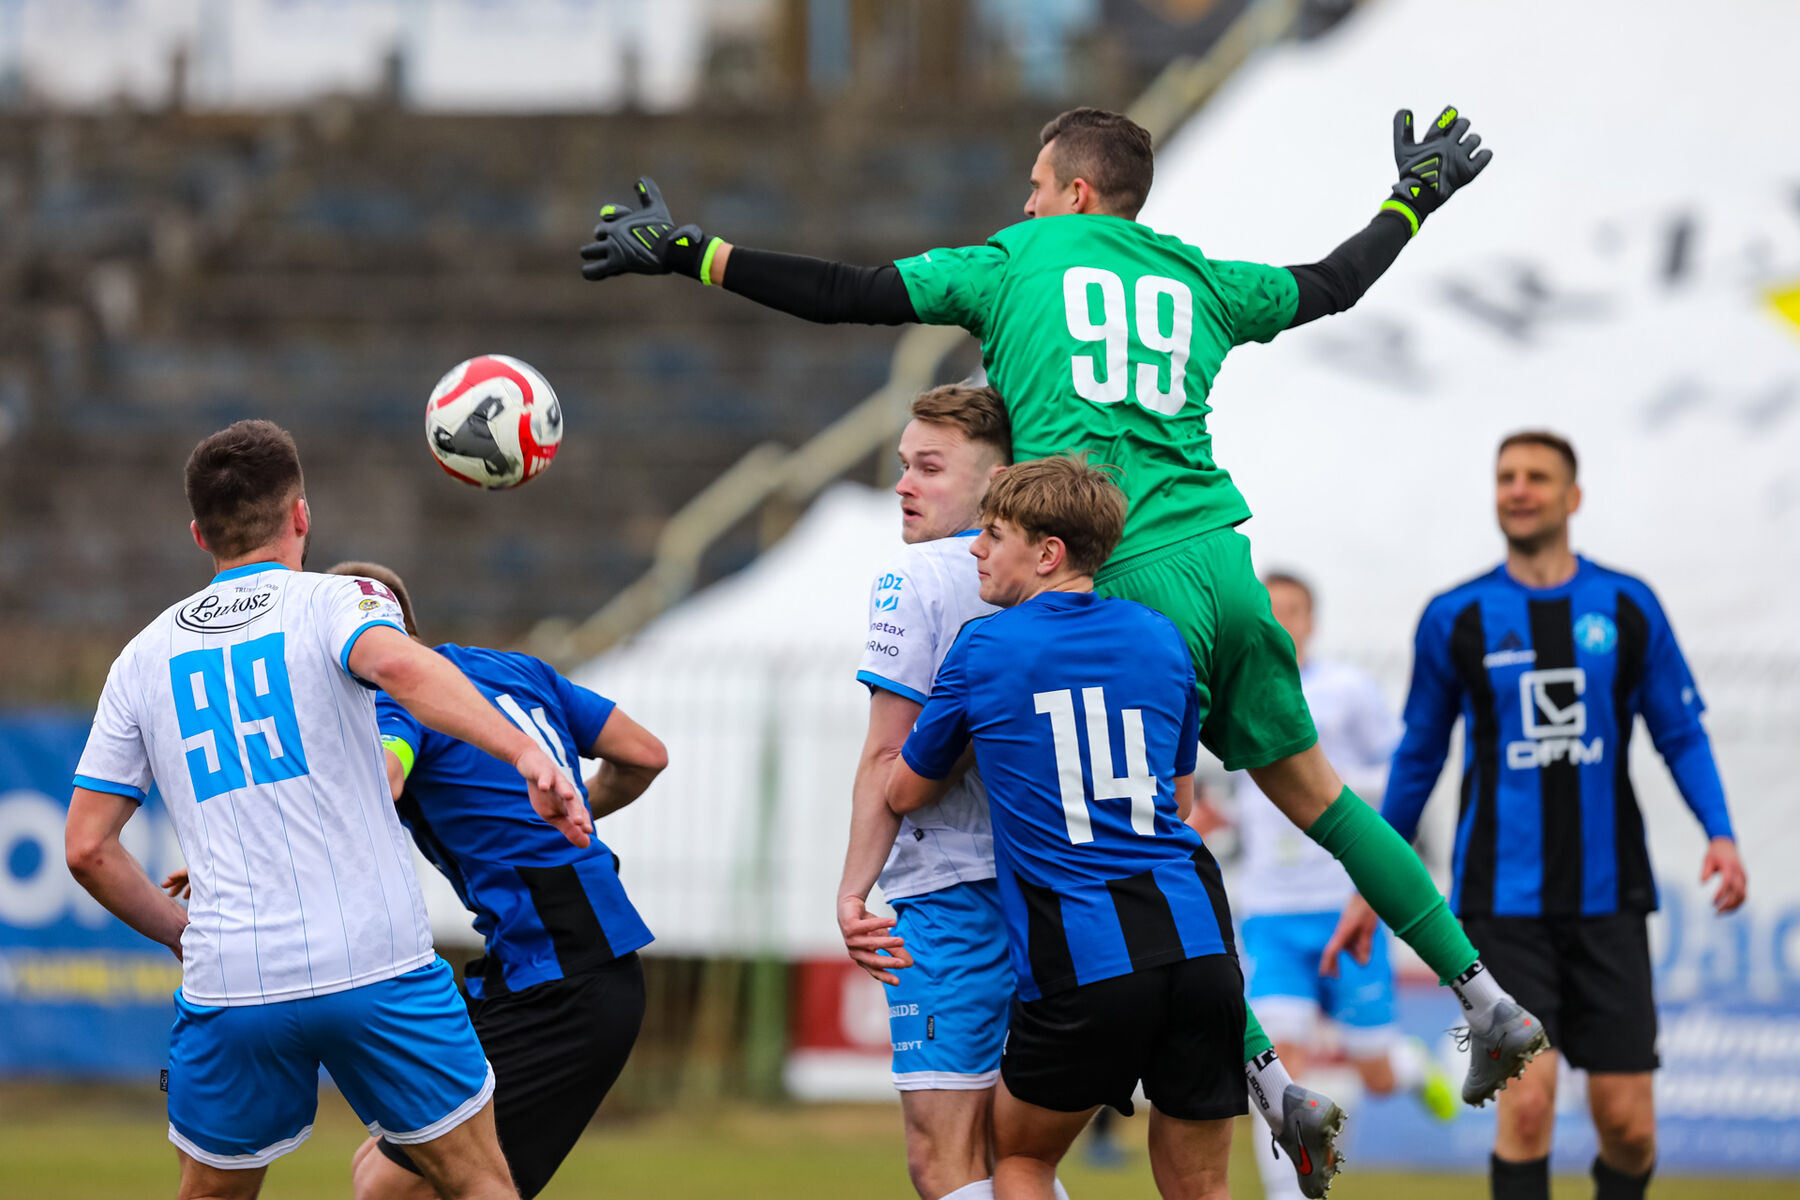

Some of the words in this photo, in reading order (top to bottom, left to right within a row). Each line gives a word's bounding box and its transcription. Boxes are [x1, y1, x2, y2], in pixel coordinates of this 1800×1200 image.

[1063, 266, 1193, 416] 99
[169, 631, 310, 803] 99
[1033, 686, 1158, 845] 14
